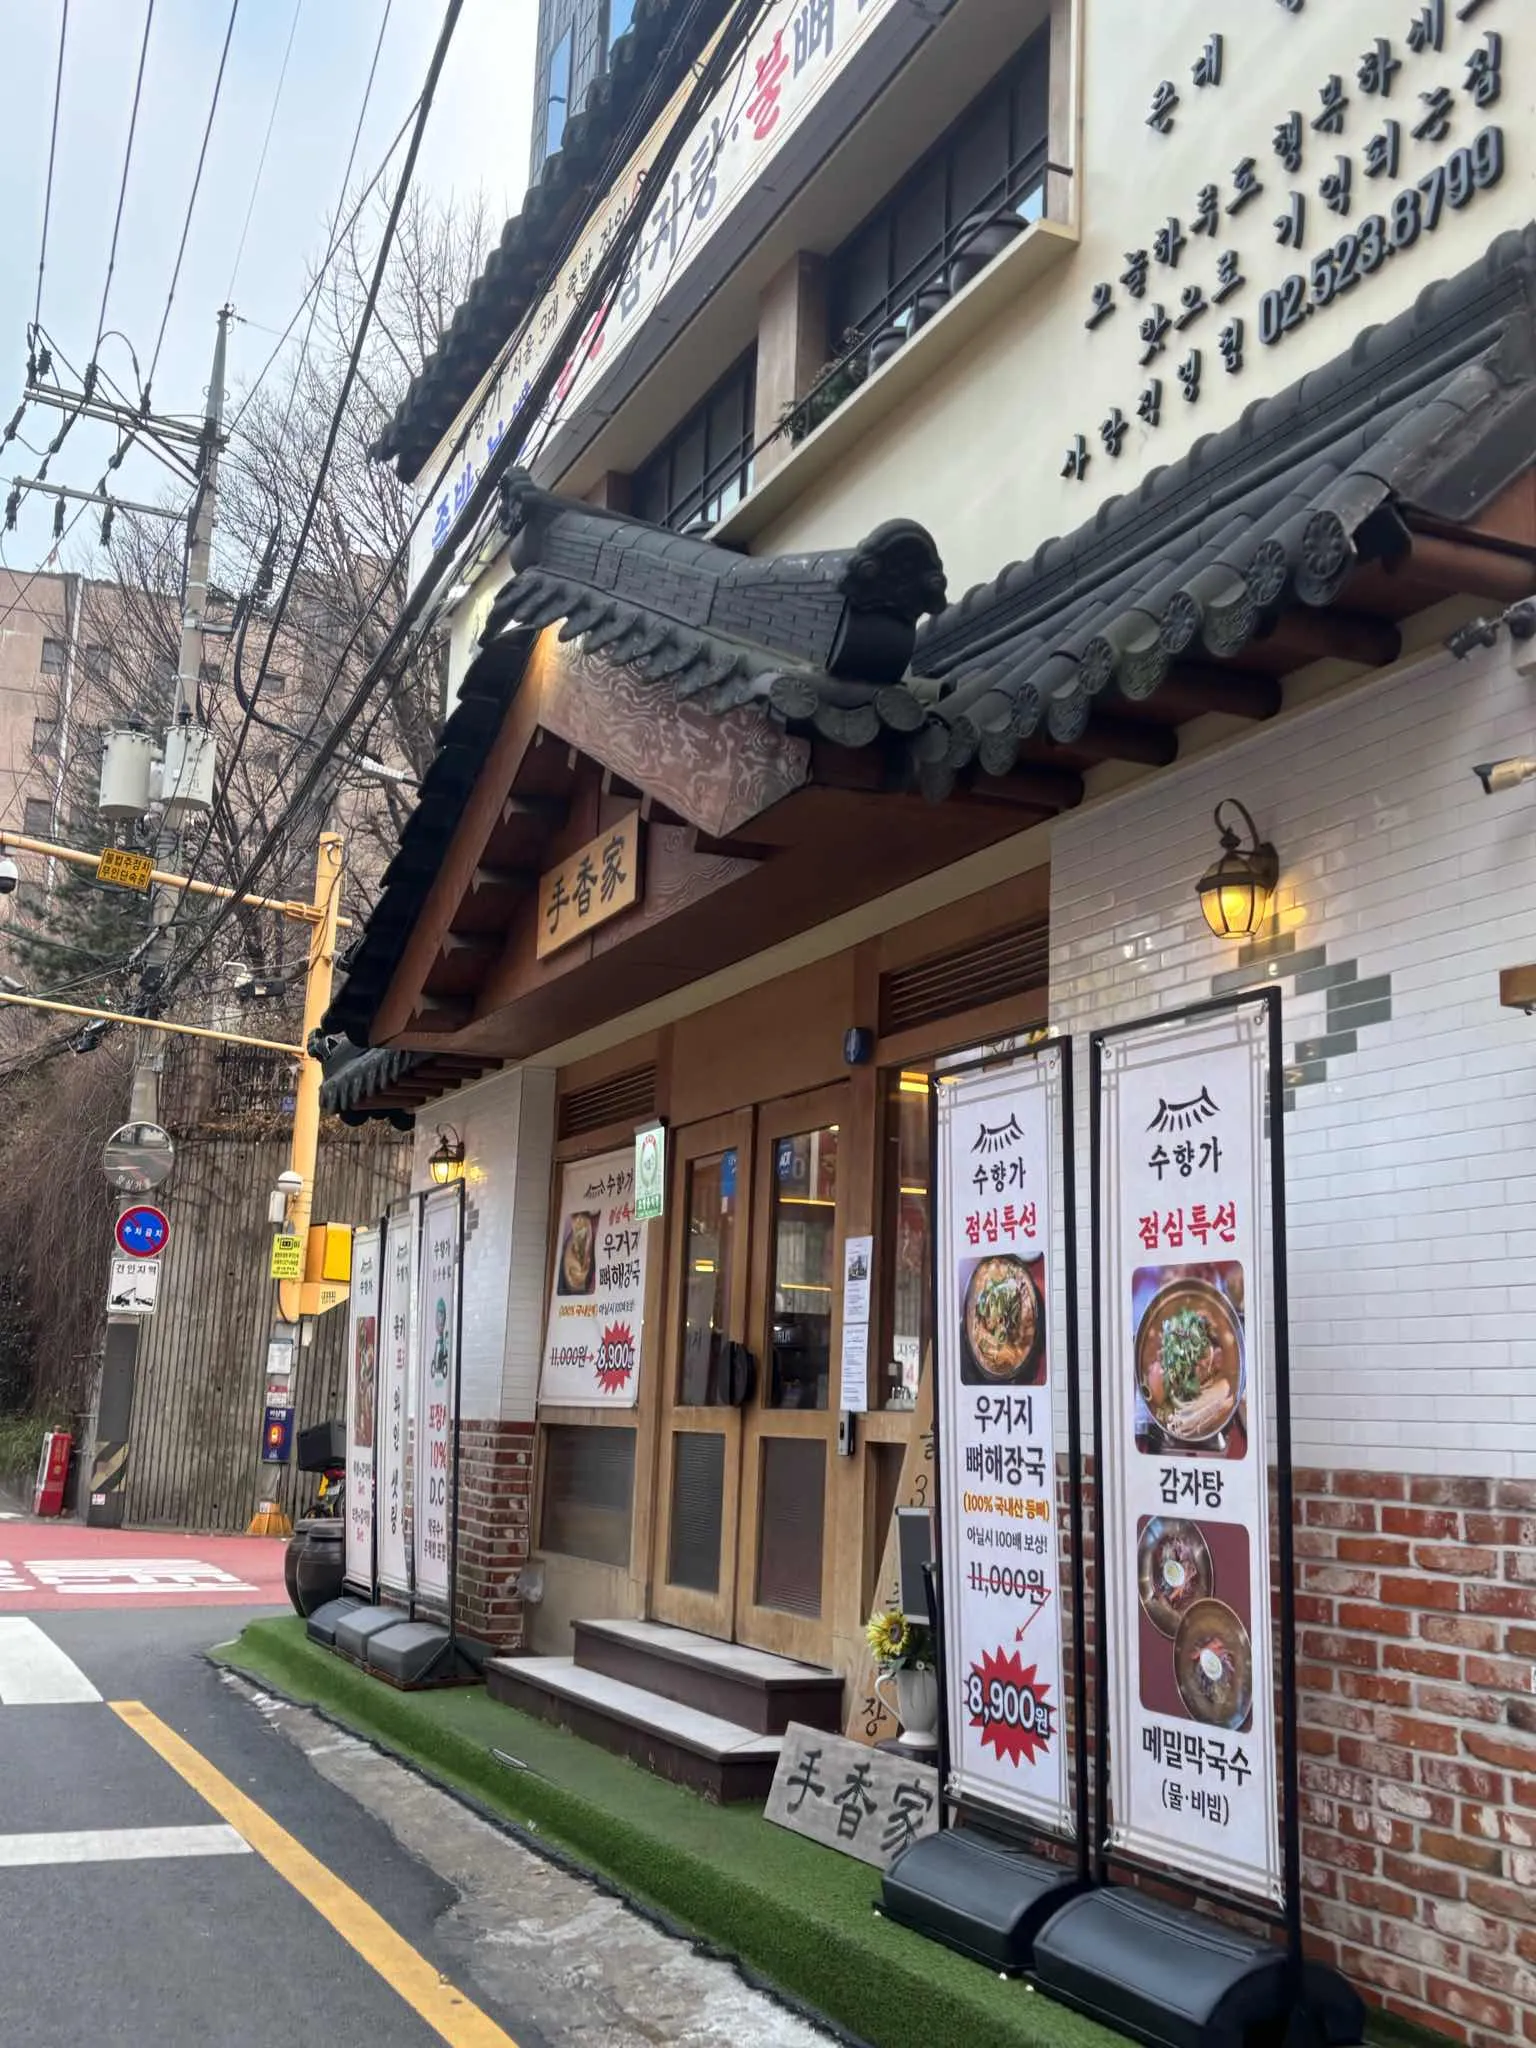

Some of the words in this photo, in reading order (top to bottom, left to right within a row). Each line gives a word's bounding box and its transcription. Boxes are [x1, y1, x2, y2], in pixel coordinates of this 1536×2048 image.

[1272, 0, 1490, 173] 행복하세
[1258, 126, 1504, 346] 02.523.8799
[1139, 249, 1246, 366] 맛으로
[547, 835, 627, 935] 手香家
[972, 1156, 1026, 1195] 수향가
[1147, 1136, 1223, 1181] 수향가
[124, 1225, 163, 1239] 주차금지
[965, 1202, 1038, 1245] 점심특선
[1138, 1201, 1238, 1250] 점심특선
[973, 1395, 1034, 1435] 우거지
[965, 1443, 1046, 1488] 뼈해장국
[1158, 1466, 1224, 1508] 감자탕
[963, 1491, 993, 1513] (100%
[994, 1496, 1023, 1518] 국내산
[966, 1526, 994, 1548] 아닐시
[1023, 1534, 1048, 1554] 보상!
[970, 1560, 1046, 1606] 11,000원
[967, 1673, 1052, 1738] 8,900원
[1141, 1723, 1252, 1787] 메밀막국수
[787, 1749, 934, 1862] 手香家
